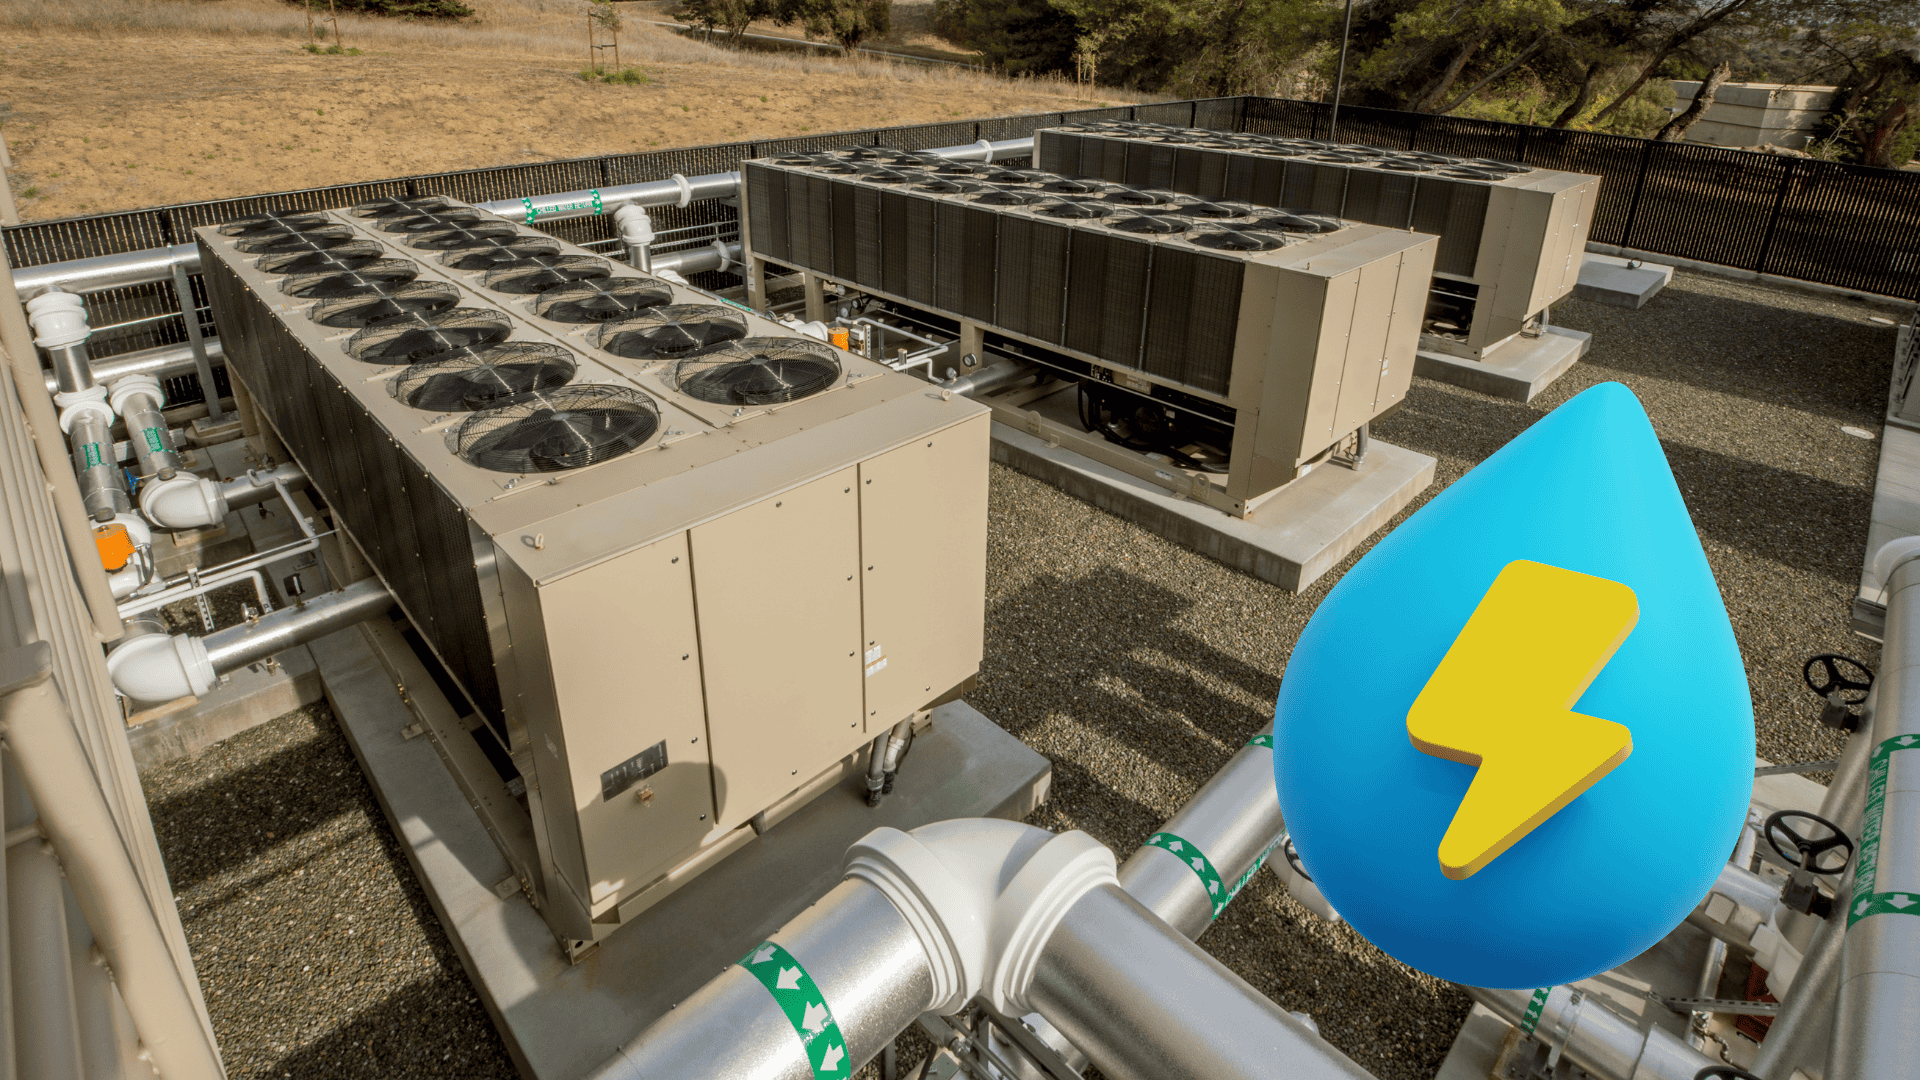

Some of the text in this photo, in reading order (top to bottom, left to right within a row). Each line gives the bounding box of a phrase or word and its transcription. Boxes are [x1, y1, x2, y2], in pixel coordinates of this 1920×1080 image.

[537, 205, 556, 214] CHILLED
[1853, 759, 1887, 900] CHILLED WATER RETURN
